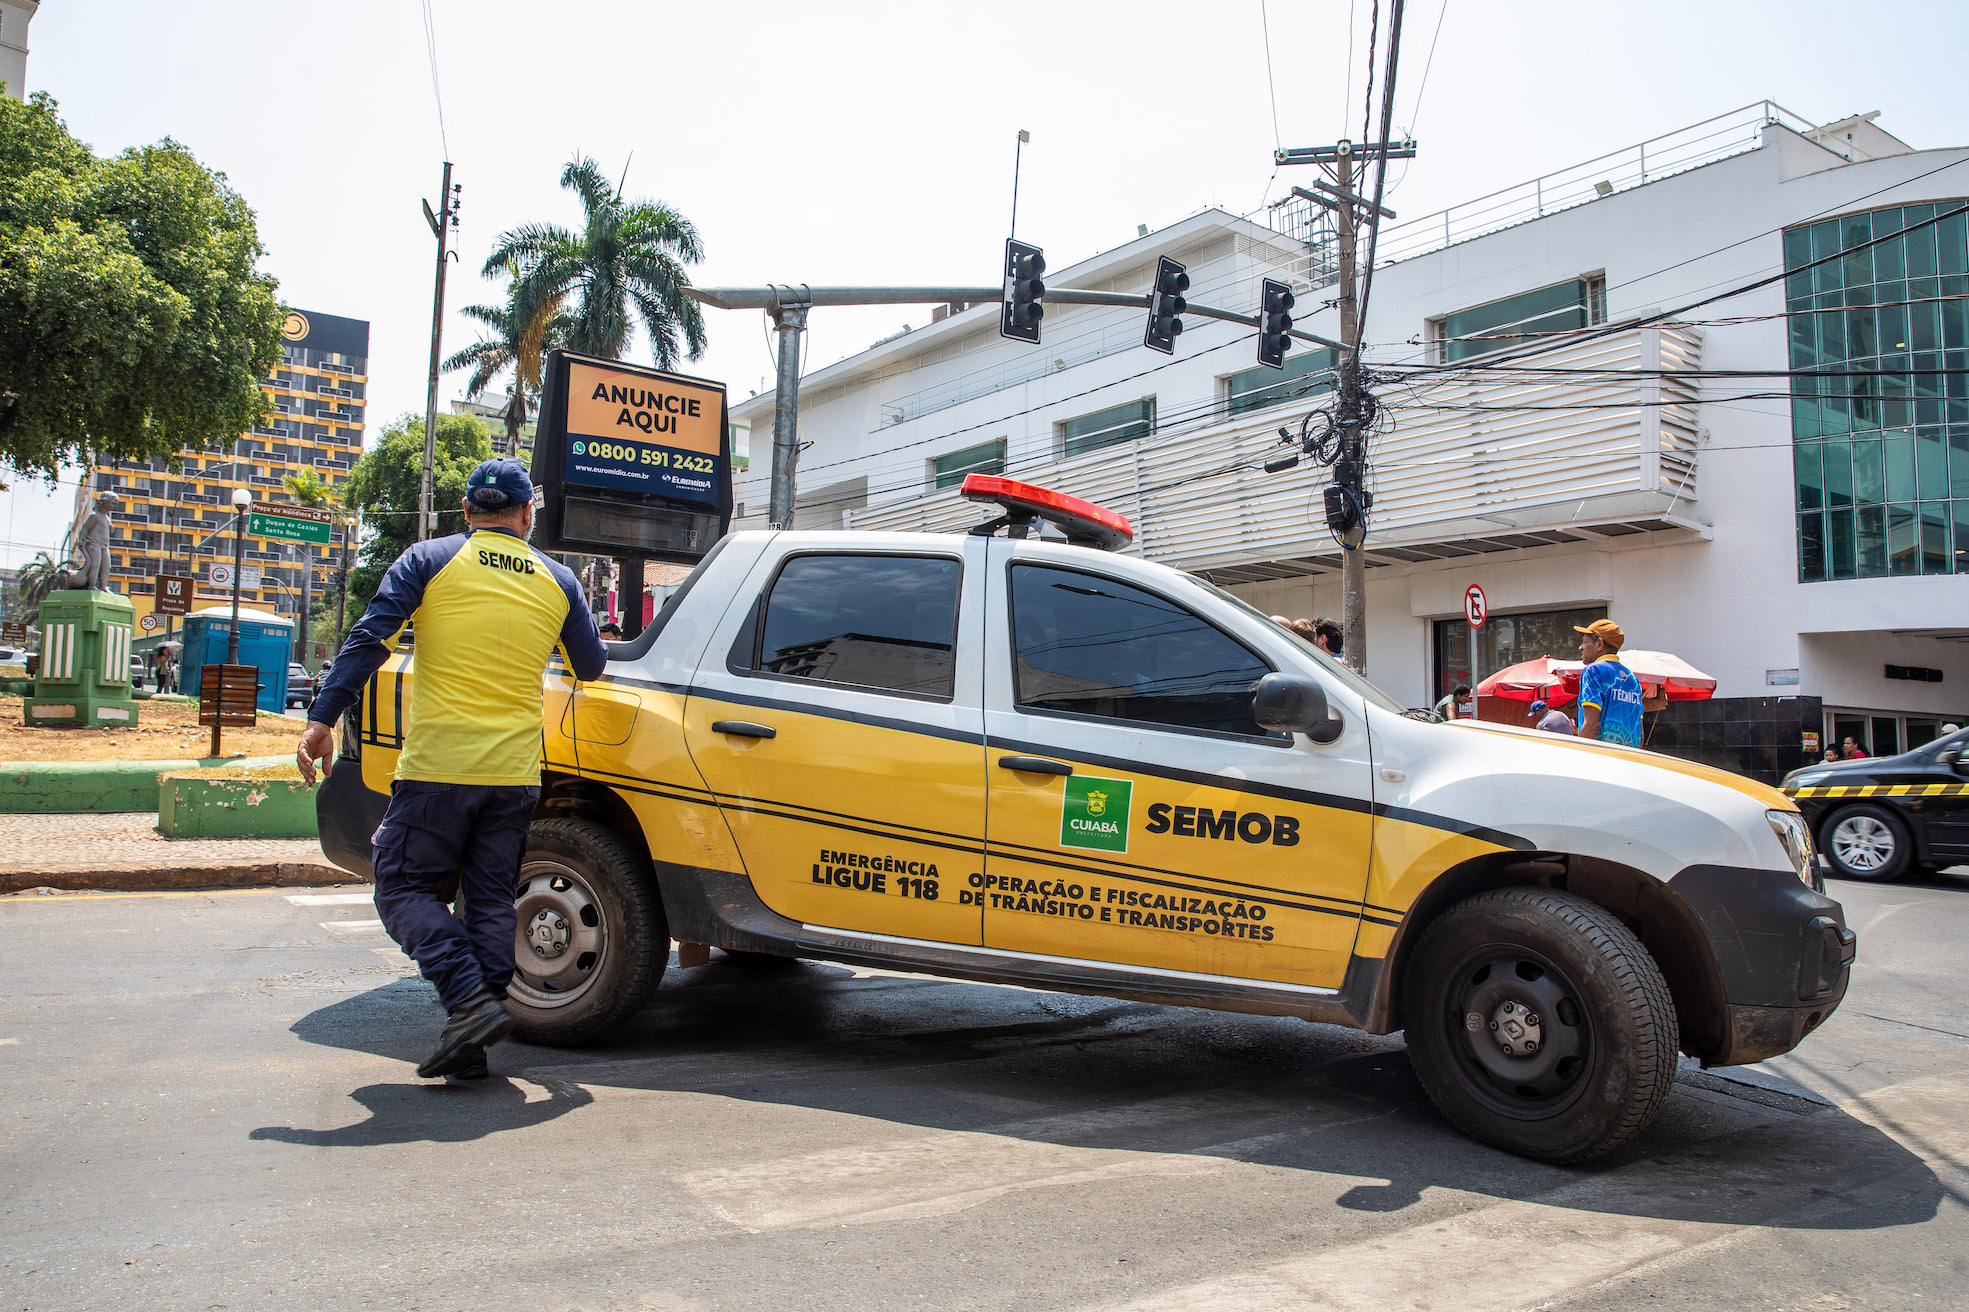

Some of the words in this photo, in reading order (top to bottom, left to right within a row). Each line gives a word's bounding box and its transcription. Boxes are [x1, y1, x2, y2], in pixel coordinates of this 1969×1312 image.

[592, 383, 700, 417] ANUNCIE
[616, 408, 676, 434] AQUI
[588, 441, 636, 462] 0800
[640, 449, 668, 467] 591
[673, 454, 714, 474] 2422
[575, 464, 649, 480] www.euromidia.com.br
[252, 504, 271, 512] Praça
[265, 519, 286, 527] Duque
[297, 523, 319, 531] Caxias
[265, 527, 284, 535] Santa
[285, 529, 300, 537] Rosa
[478, 550, 535, 575] SEMOB
[143, 618, 155, 627] 50
[1070, 818, 1119, 835] CUIABÁ
[1076, 830, 1112, 839] PREFEITURA
[1145, 802, 1301, 847] SEMOB
[820, 849, 939, 878] EMERGÊNCIA
[812, 863, 886, 894] LIGUE
[896, 876, 939, 901] 118
[968, 872, 1084, 901] OPERAÇÃO
[1090, 886, 1101, 902] E
[1107, 888, 1266, 922] FISCALIZAÇÃO
[959, 889, 984, 906] DE
[990, 892, 1094, 919] TRÂNSITO
[1100, 906, 1111, 922] E
[1116, 908, 1275, 942] TRANSPORTES
